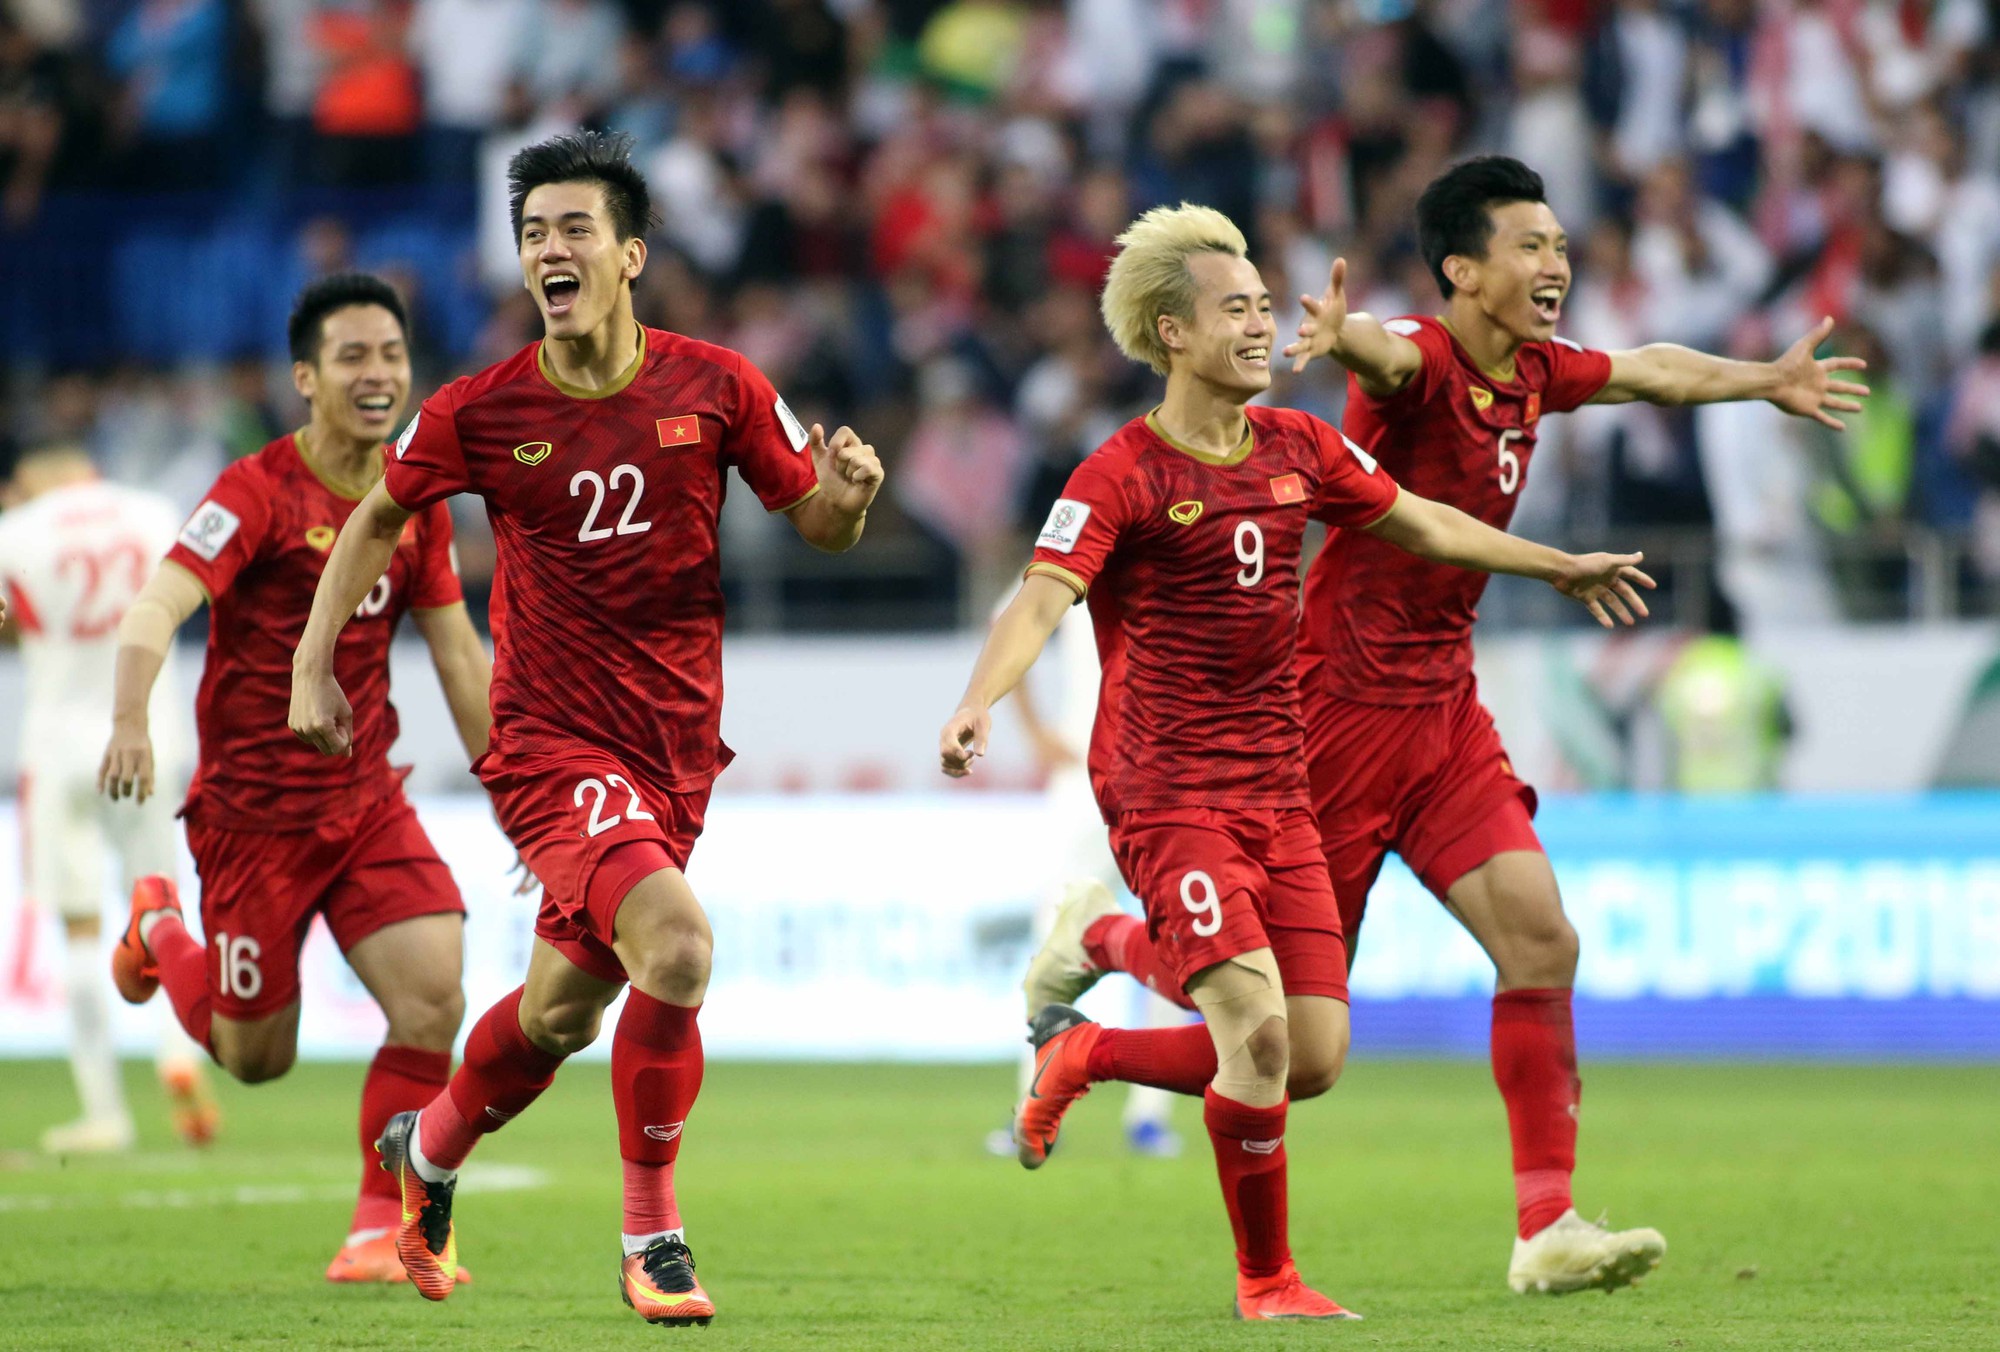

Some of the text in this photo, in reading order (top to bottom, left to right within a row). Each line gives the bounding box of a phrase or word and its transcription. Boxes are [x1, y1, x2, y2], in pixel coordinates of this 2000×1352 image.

[1498, 429, 1523, 495] 5
[569, 463, 652, 543] 22
[1233, 520, 1264, 588] 9
[573, 773, 655, 838] 22
[1180, 869, 1223, 937] 9
[214, 931, 262, 1000] 16
